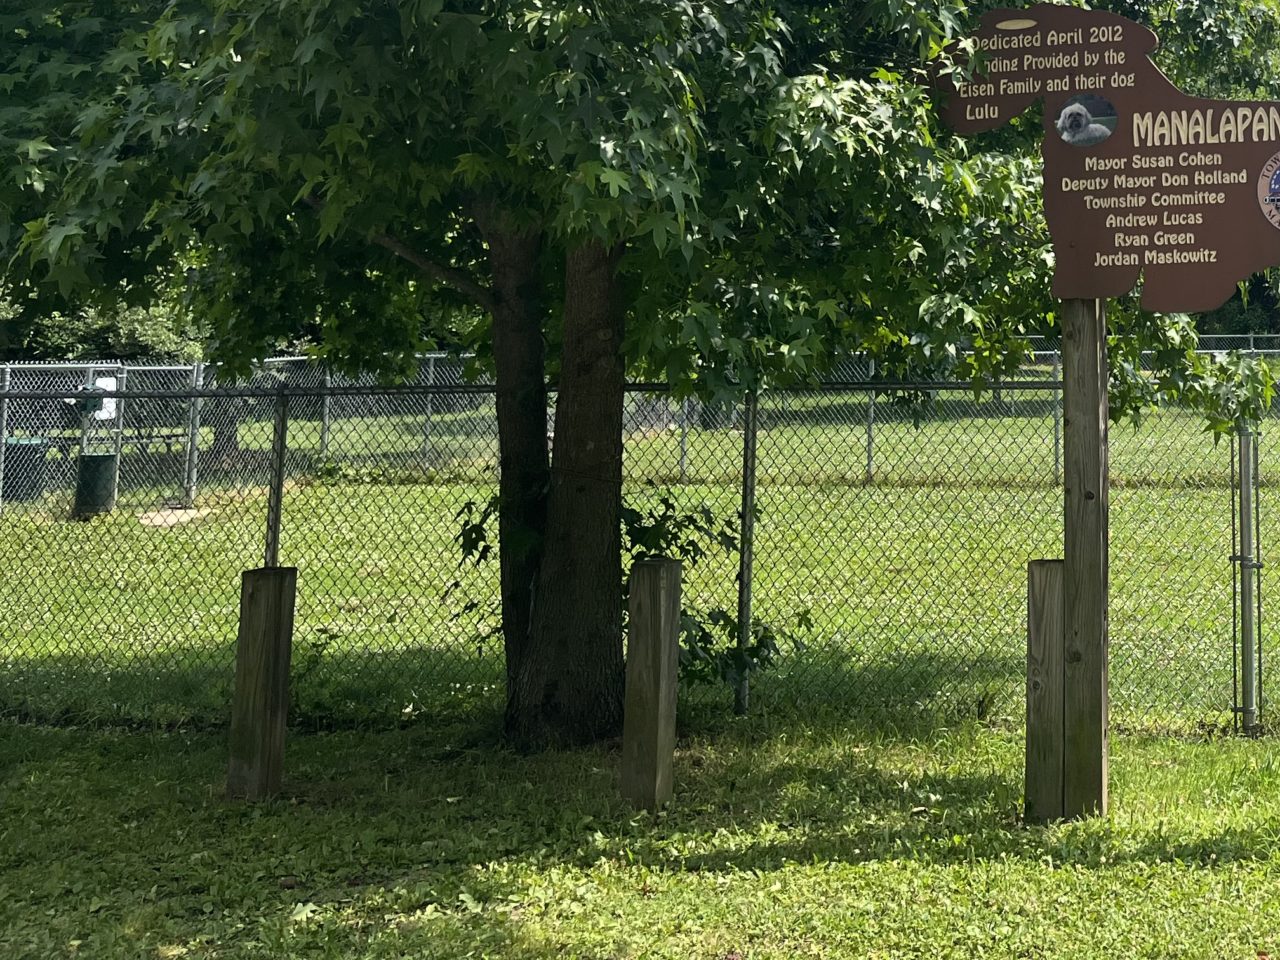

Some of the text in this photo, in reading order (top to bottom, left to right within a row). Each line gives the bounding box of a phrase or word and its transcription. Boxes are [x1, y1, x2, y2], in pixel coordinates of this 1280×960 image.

[970, 25, 1124, 51] Dedicated April 2012
[1024, 52, 1079, 70] Provided
[1084, 50, 1100, 66] by
[1104, 49, 1126, 64] the
[960, 72, 1135, 98] Eisen Family and their dog
[966, 103, 999, 120] Lulu
[1085, 152, 1222, 171] Mayor Susan Cohen
[1062, 169, 1247, 192] Deputy Mayor Don Holland
[1084, 191, 1226, 209] Township Committee
[1106, 211, 1203, 228] Andrew Lucas
[1114, 230, 1195, 247] Ryan Green
[1094, 248, 1217, 266] Jordan Maskowitz
